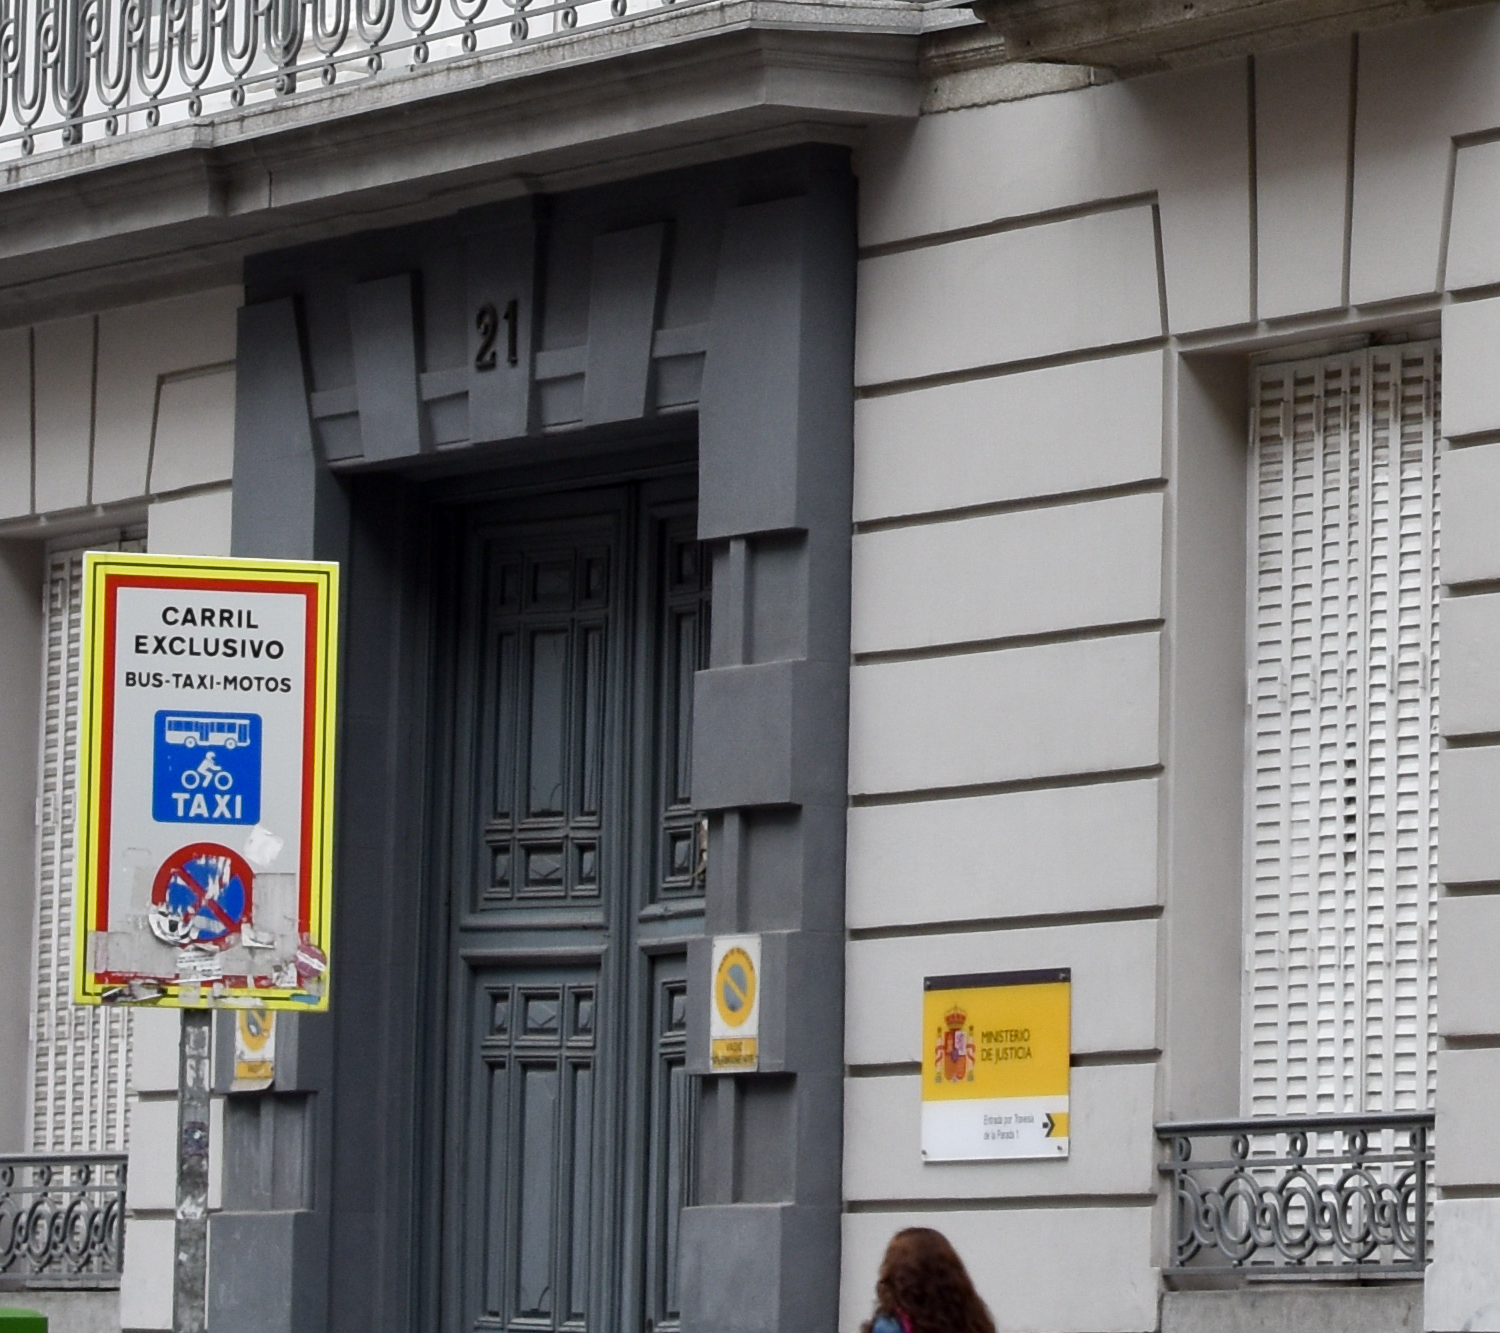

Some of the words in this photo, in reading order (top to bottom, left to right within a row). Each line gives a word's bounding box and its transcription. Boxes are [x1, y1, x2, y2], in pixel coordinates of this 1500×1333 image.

[475, 299, 519, 373] 21
[161, 606, 259, 629] CARRIL
[134, 635, 284, 660] EXCLUSIVO
[125, 671, 292, 693] BUS-TAXI-MOTOS
[171, 792, 242, 819] TAXI
[981, 1028, 1031, 1044] MINISTERIO
[981, 1047, 993, 1062] DE
[994, 1046, 1032, 1065] JUSTICIA
